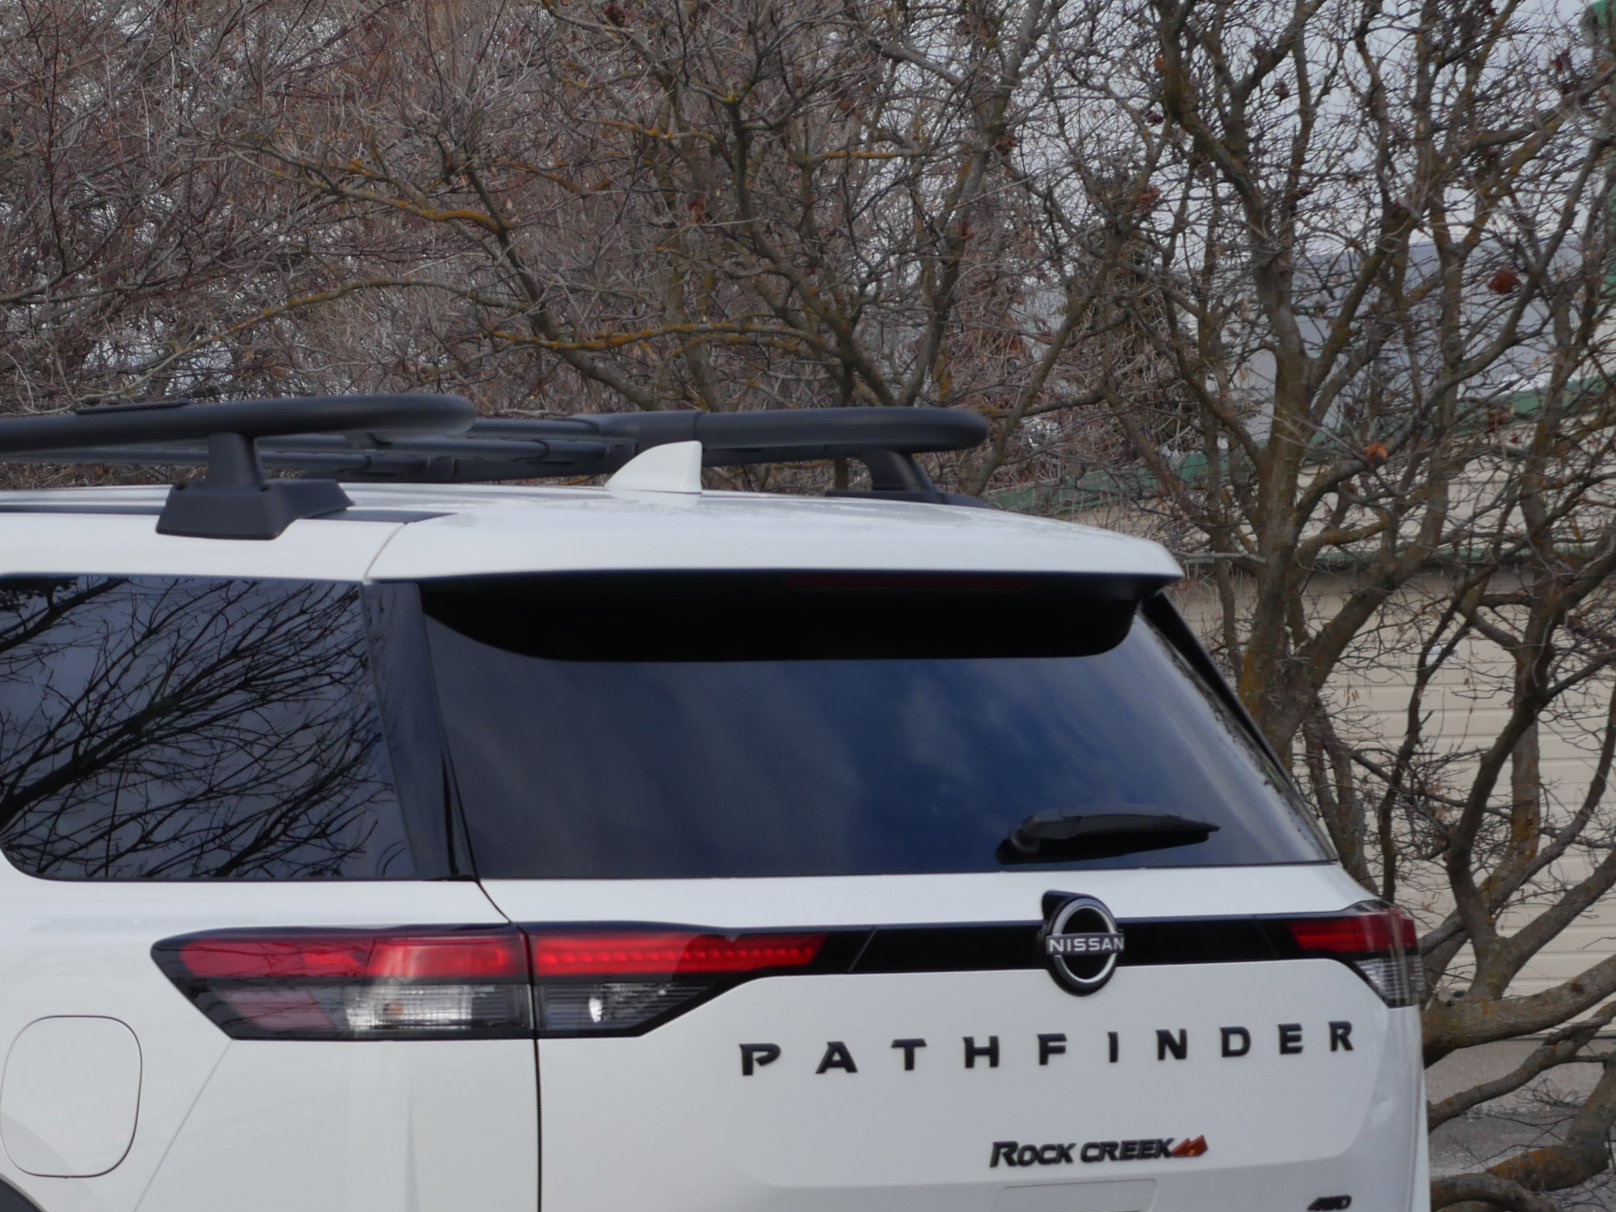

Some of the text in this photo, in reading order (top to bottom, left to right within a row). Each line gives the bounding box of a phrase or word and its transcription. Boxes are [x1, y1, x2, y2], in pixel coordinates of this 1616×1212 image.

[1048, 936, 1125, 953] NISSAN
[739, 1021, 1354, 1076] PATHFINDER
[989, 1138, 1175, 1168] ROCK CREEK
